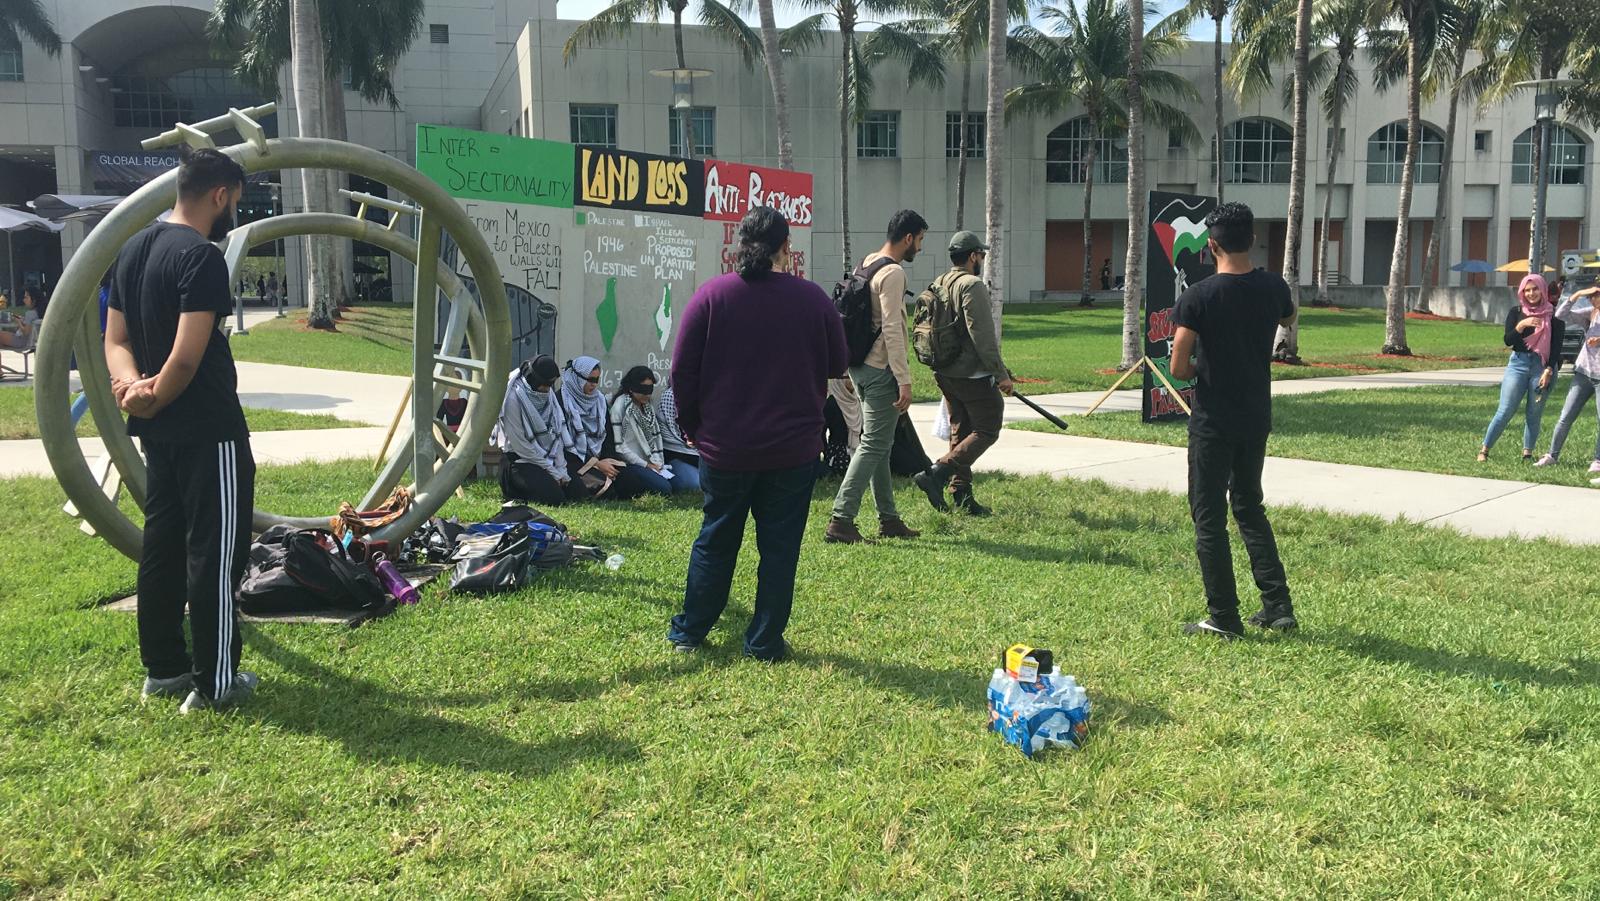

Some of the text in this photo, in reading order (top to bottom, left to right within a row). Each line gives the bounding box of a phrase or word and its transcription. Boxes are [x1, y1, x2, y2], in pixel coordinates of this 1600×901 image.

[418, 126, 480, 157] INTER
[99, 155, 180, 167] GLOBAL REACH
[446, 157, 572, 201] SECTIONALITY
[582, 148, 688, 206] LAND LOSS
[505, 208, 550, 237] Mexico
[492, 235, 507, 252] to
[597, 235, 624, 254] 1946
[646, 235, 693, 258] PROPOSED
[583, 249, 638, 278] PALESTINE
[640, 254, 655, 267] UN
[654, 265, 683, 280] PLAN
